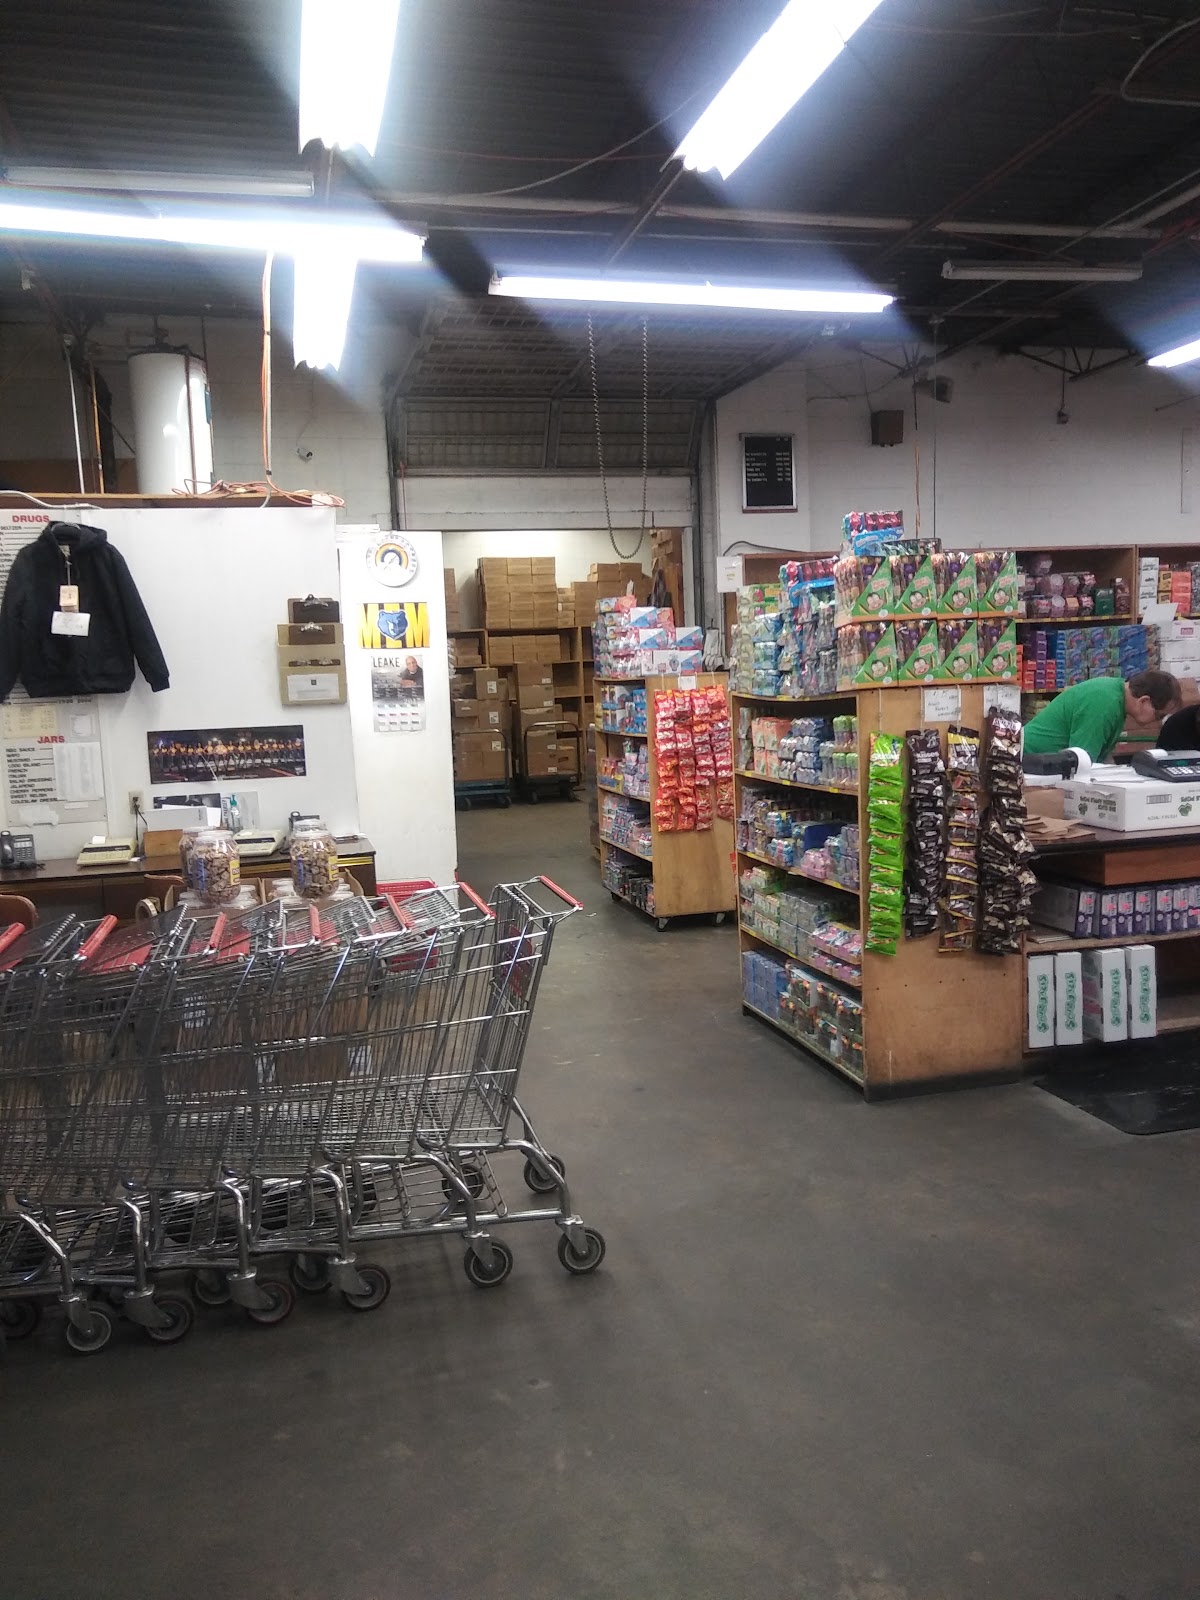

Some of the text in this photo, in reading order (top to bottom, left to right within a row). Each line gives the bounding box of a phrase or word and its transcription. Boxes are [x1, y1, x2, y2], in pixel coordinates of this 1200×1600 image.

[12, 515, 50, 523] DRUGS
[373, 657, 400, 668] LEAKE
[37, 735, 65, 744] JARS
